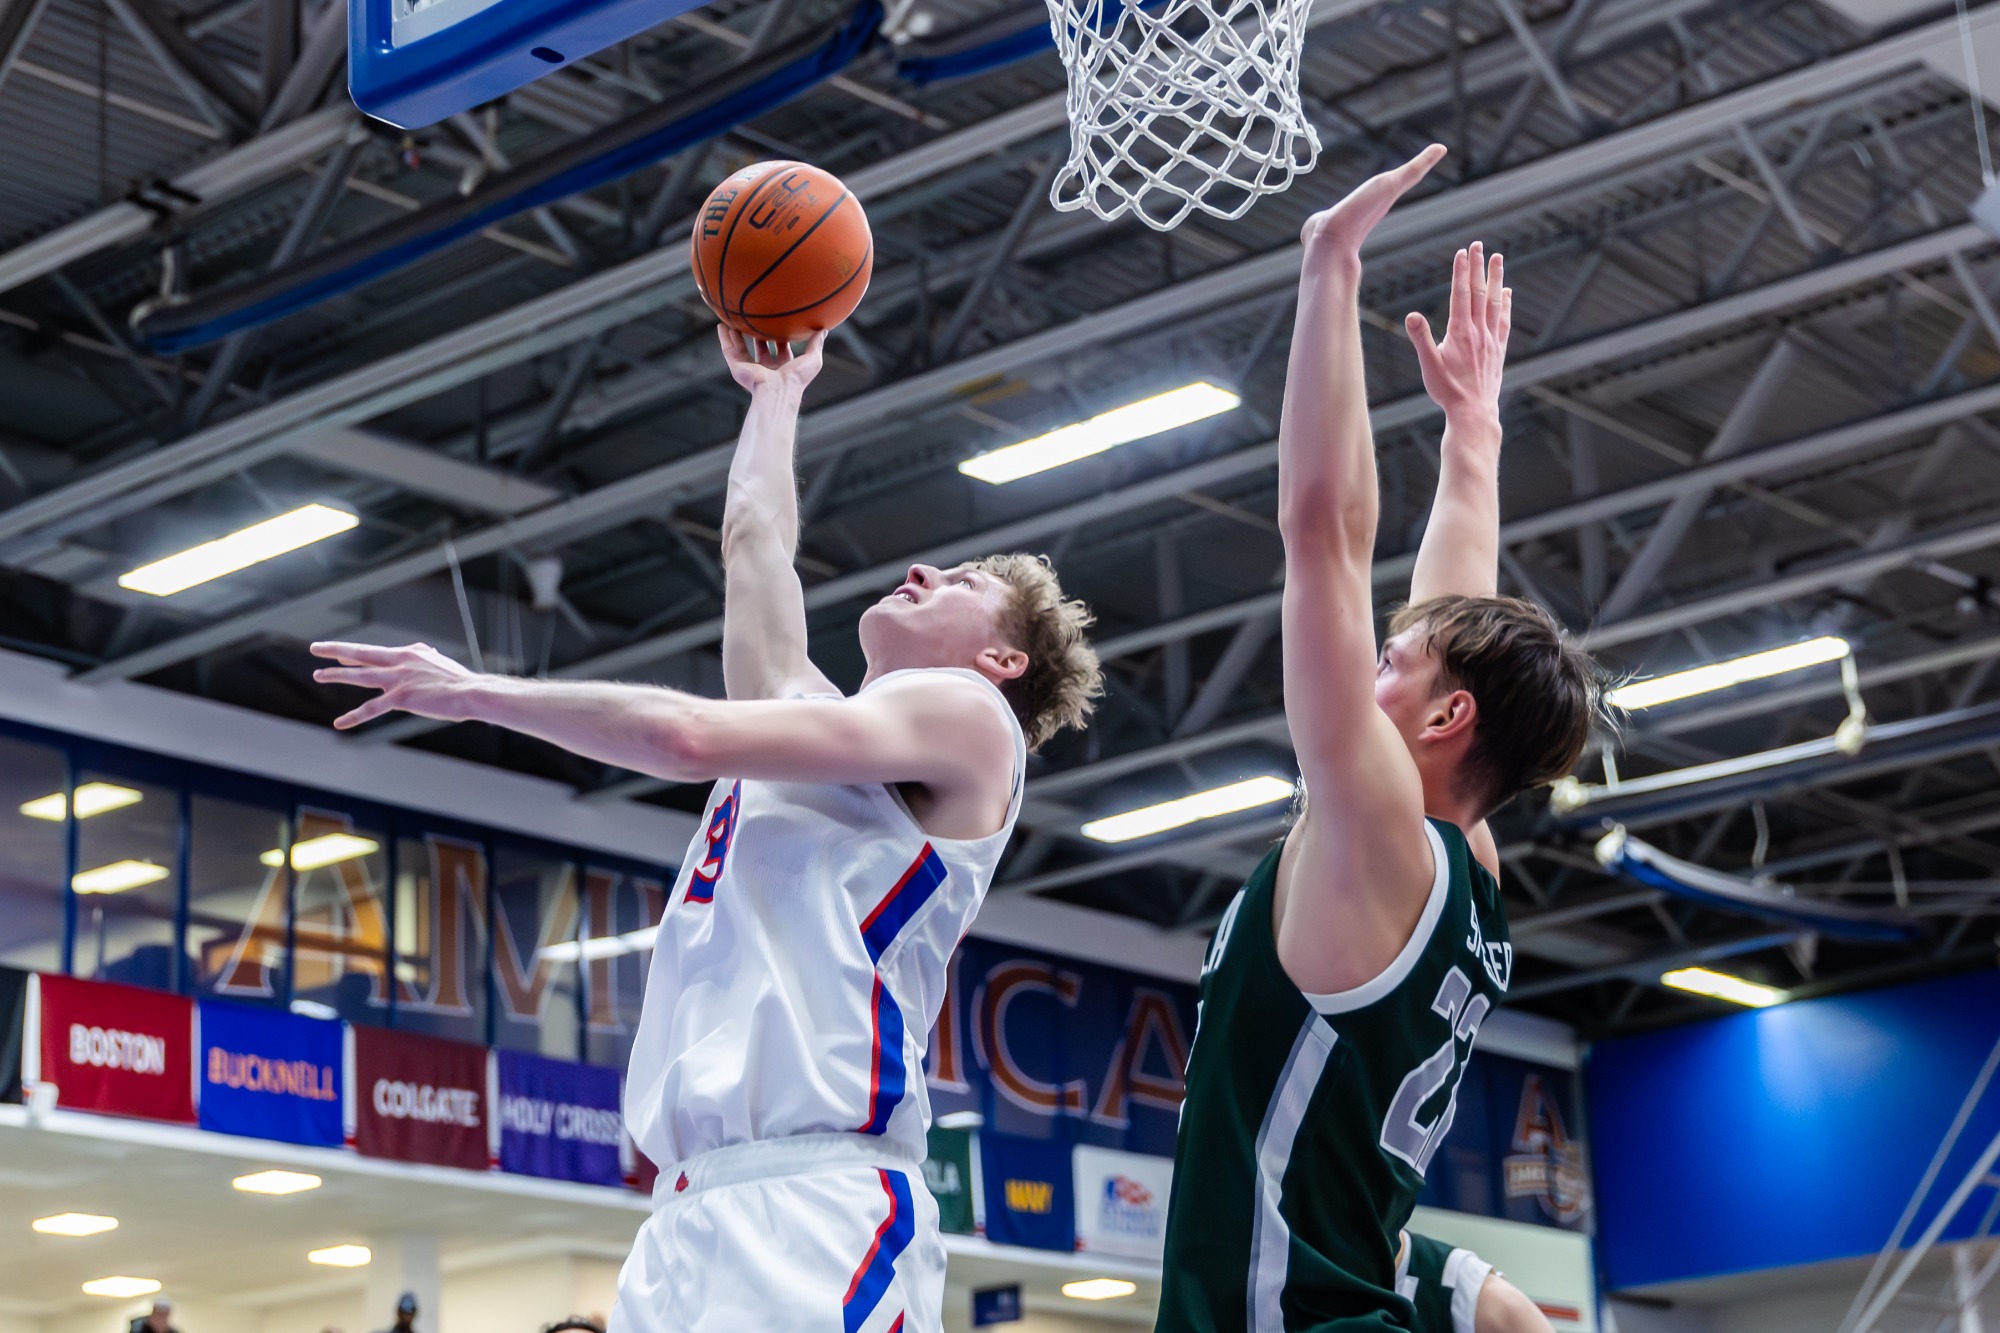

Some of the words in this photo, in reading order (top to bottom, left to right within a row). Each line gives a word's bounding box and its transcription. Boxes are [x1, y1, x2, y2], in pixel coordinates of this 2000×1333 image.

[703, 188, 738, 240] THE
[69, 1022, 166, 1076] BOSTON
[207, 1046, 338, 1101] BUCKNELL
[373, 1077, 480, 1128] COLGATE
[500, 1094, 554, 1136] HOLY
[555, 1103, 622, 1146] CROSS
